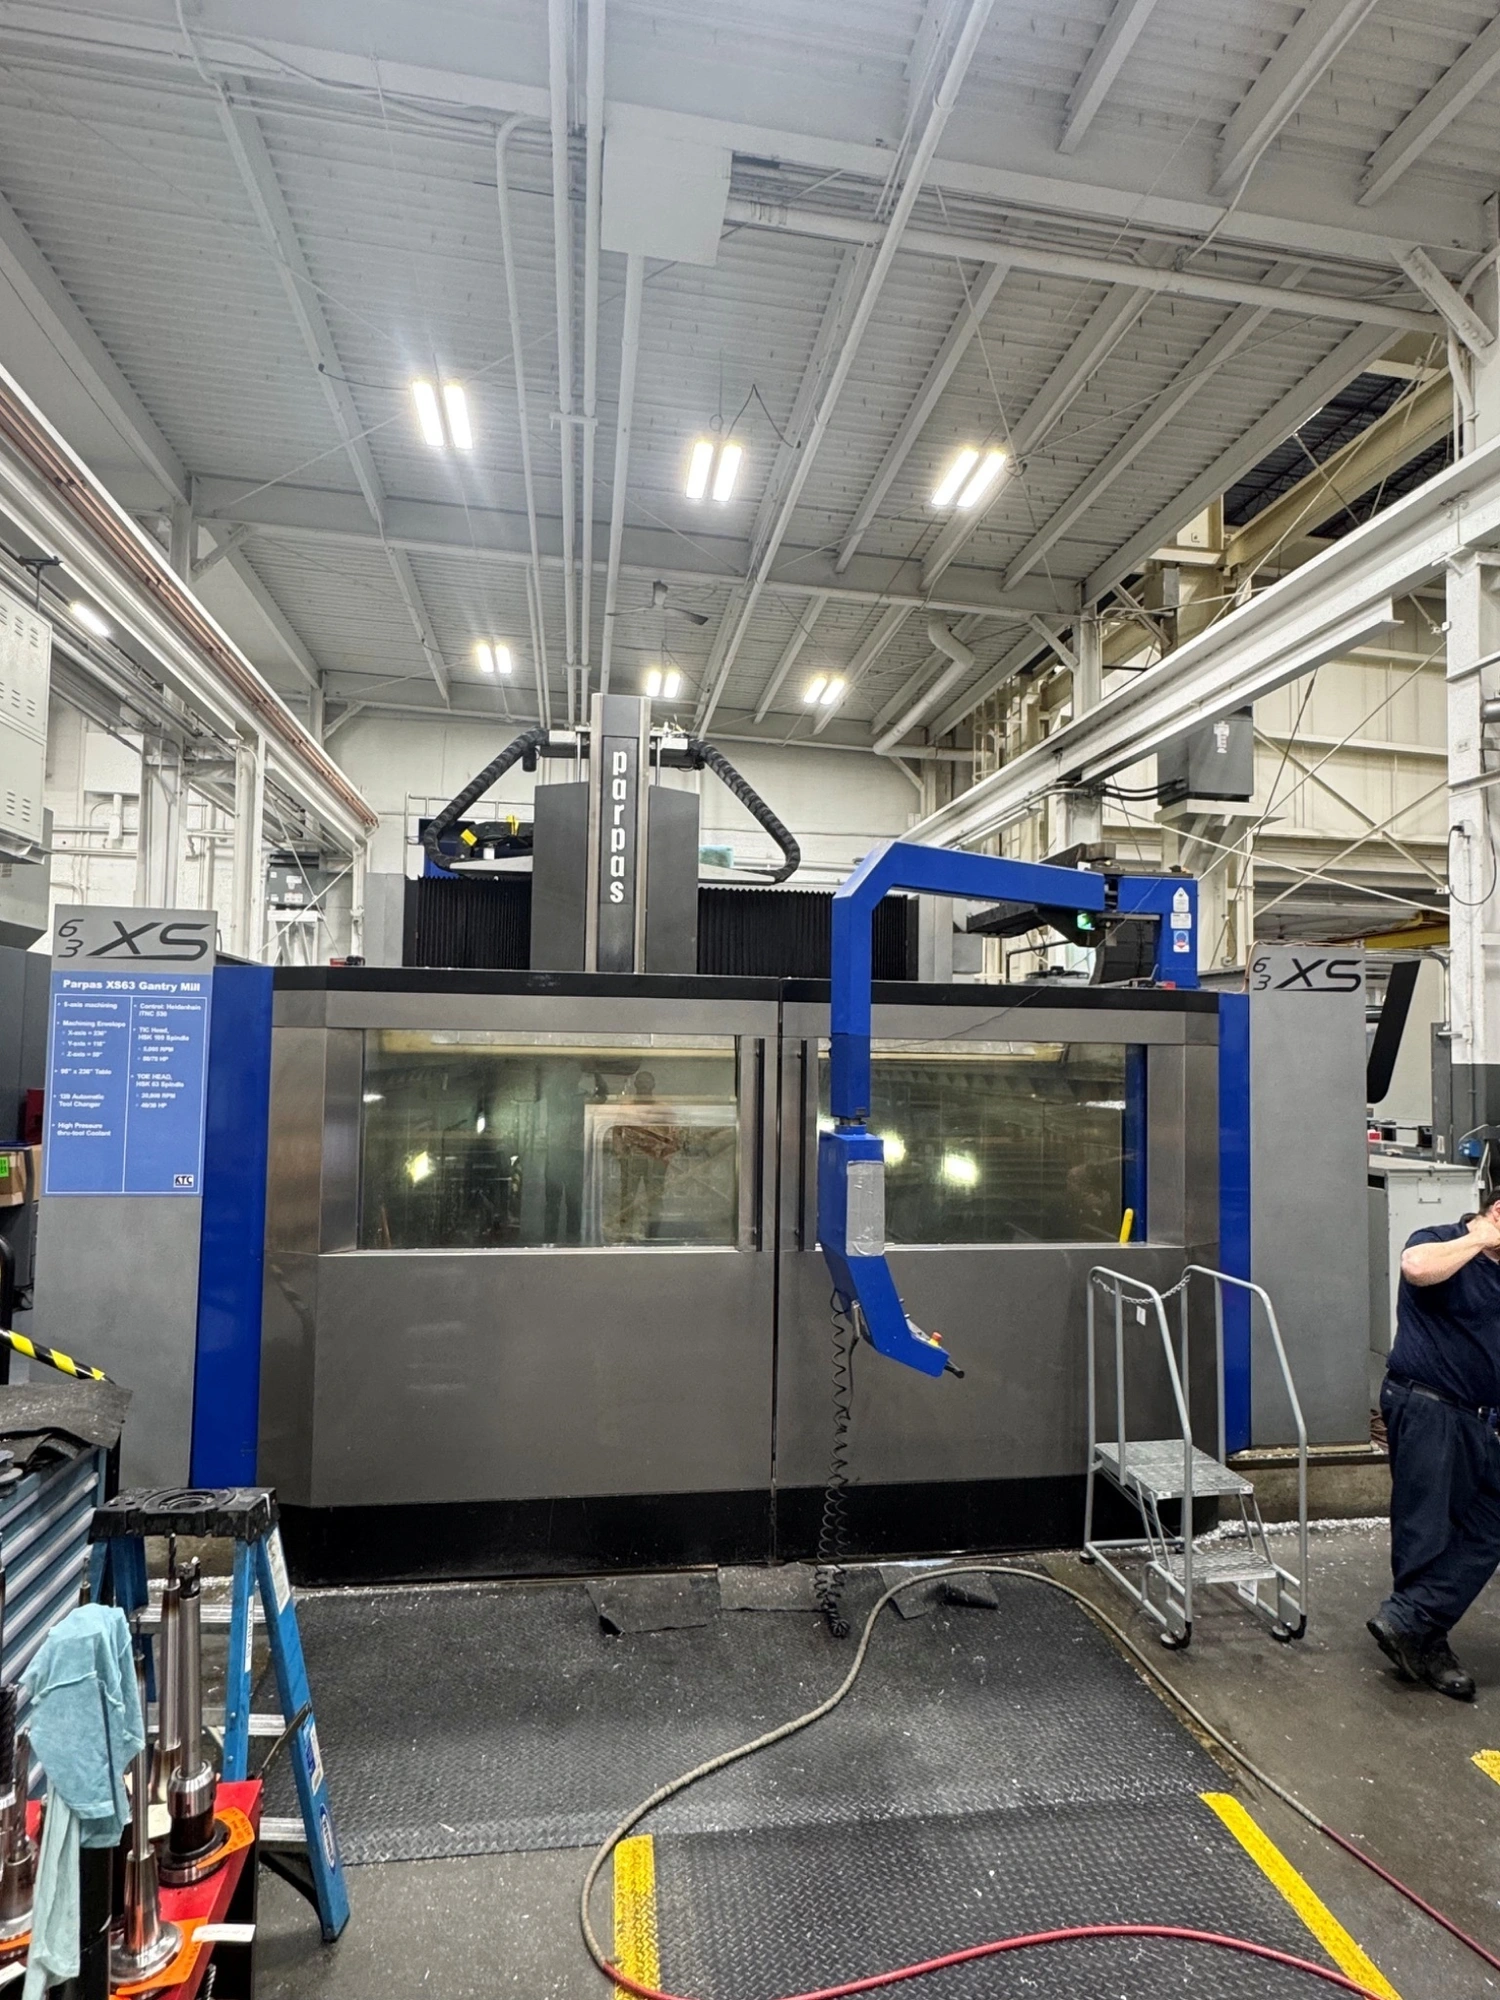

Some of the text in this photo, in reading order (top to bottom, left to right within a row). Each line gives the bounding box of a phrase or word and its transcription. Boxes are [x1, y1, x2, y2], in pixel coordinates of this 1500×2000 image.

[610, 751, 627, 903] parpas
[86, 920, 211, 960] XS
[63, 979, 200, 993] Parpas XS63 Gantry Mill
[1274, 959, 1362, 992] XS
